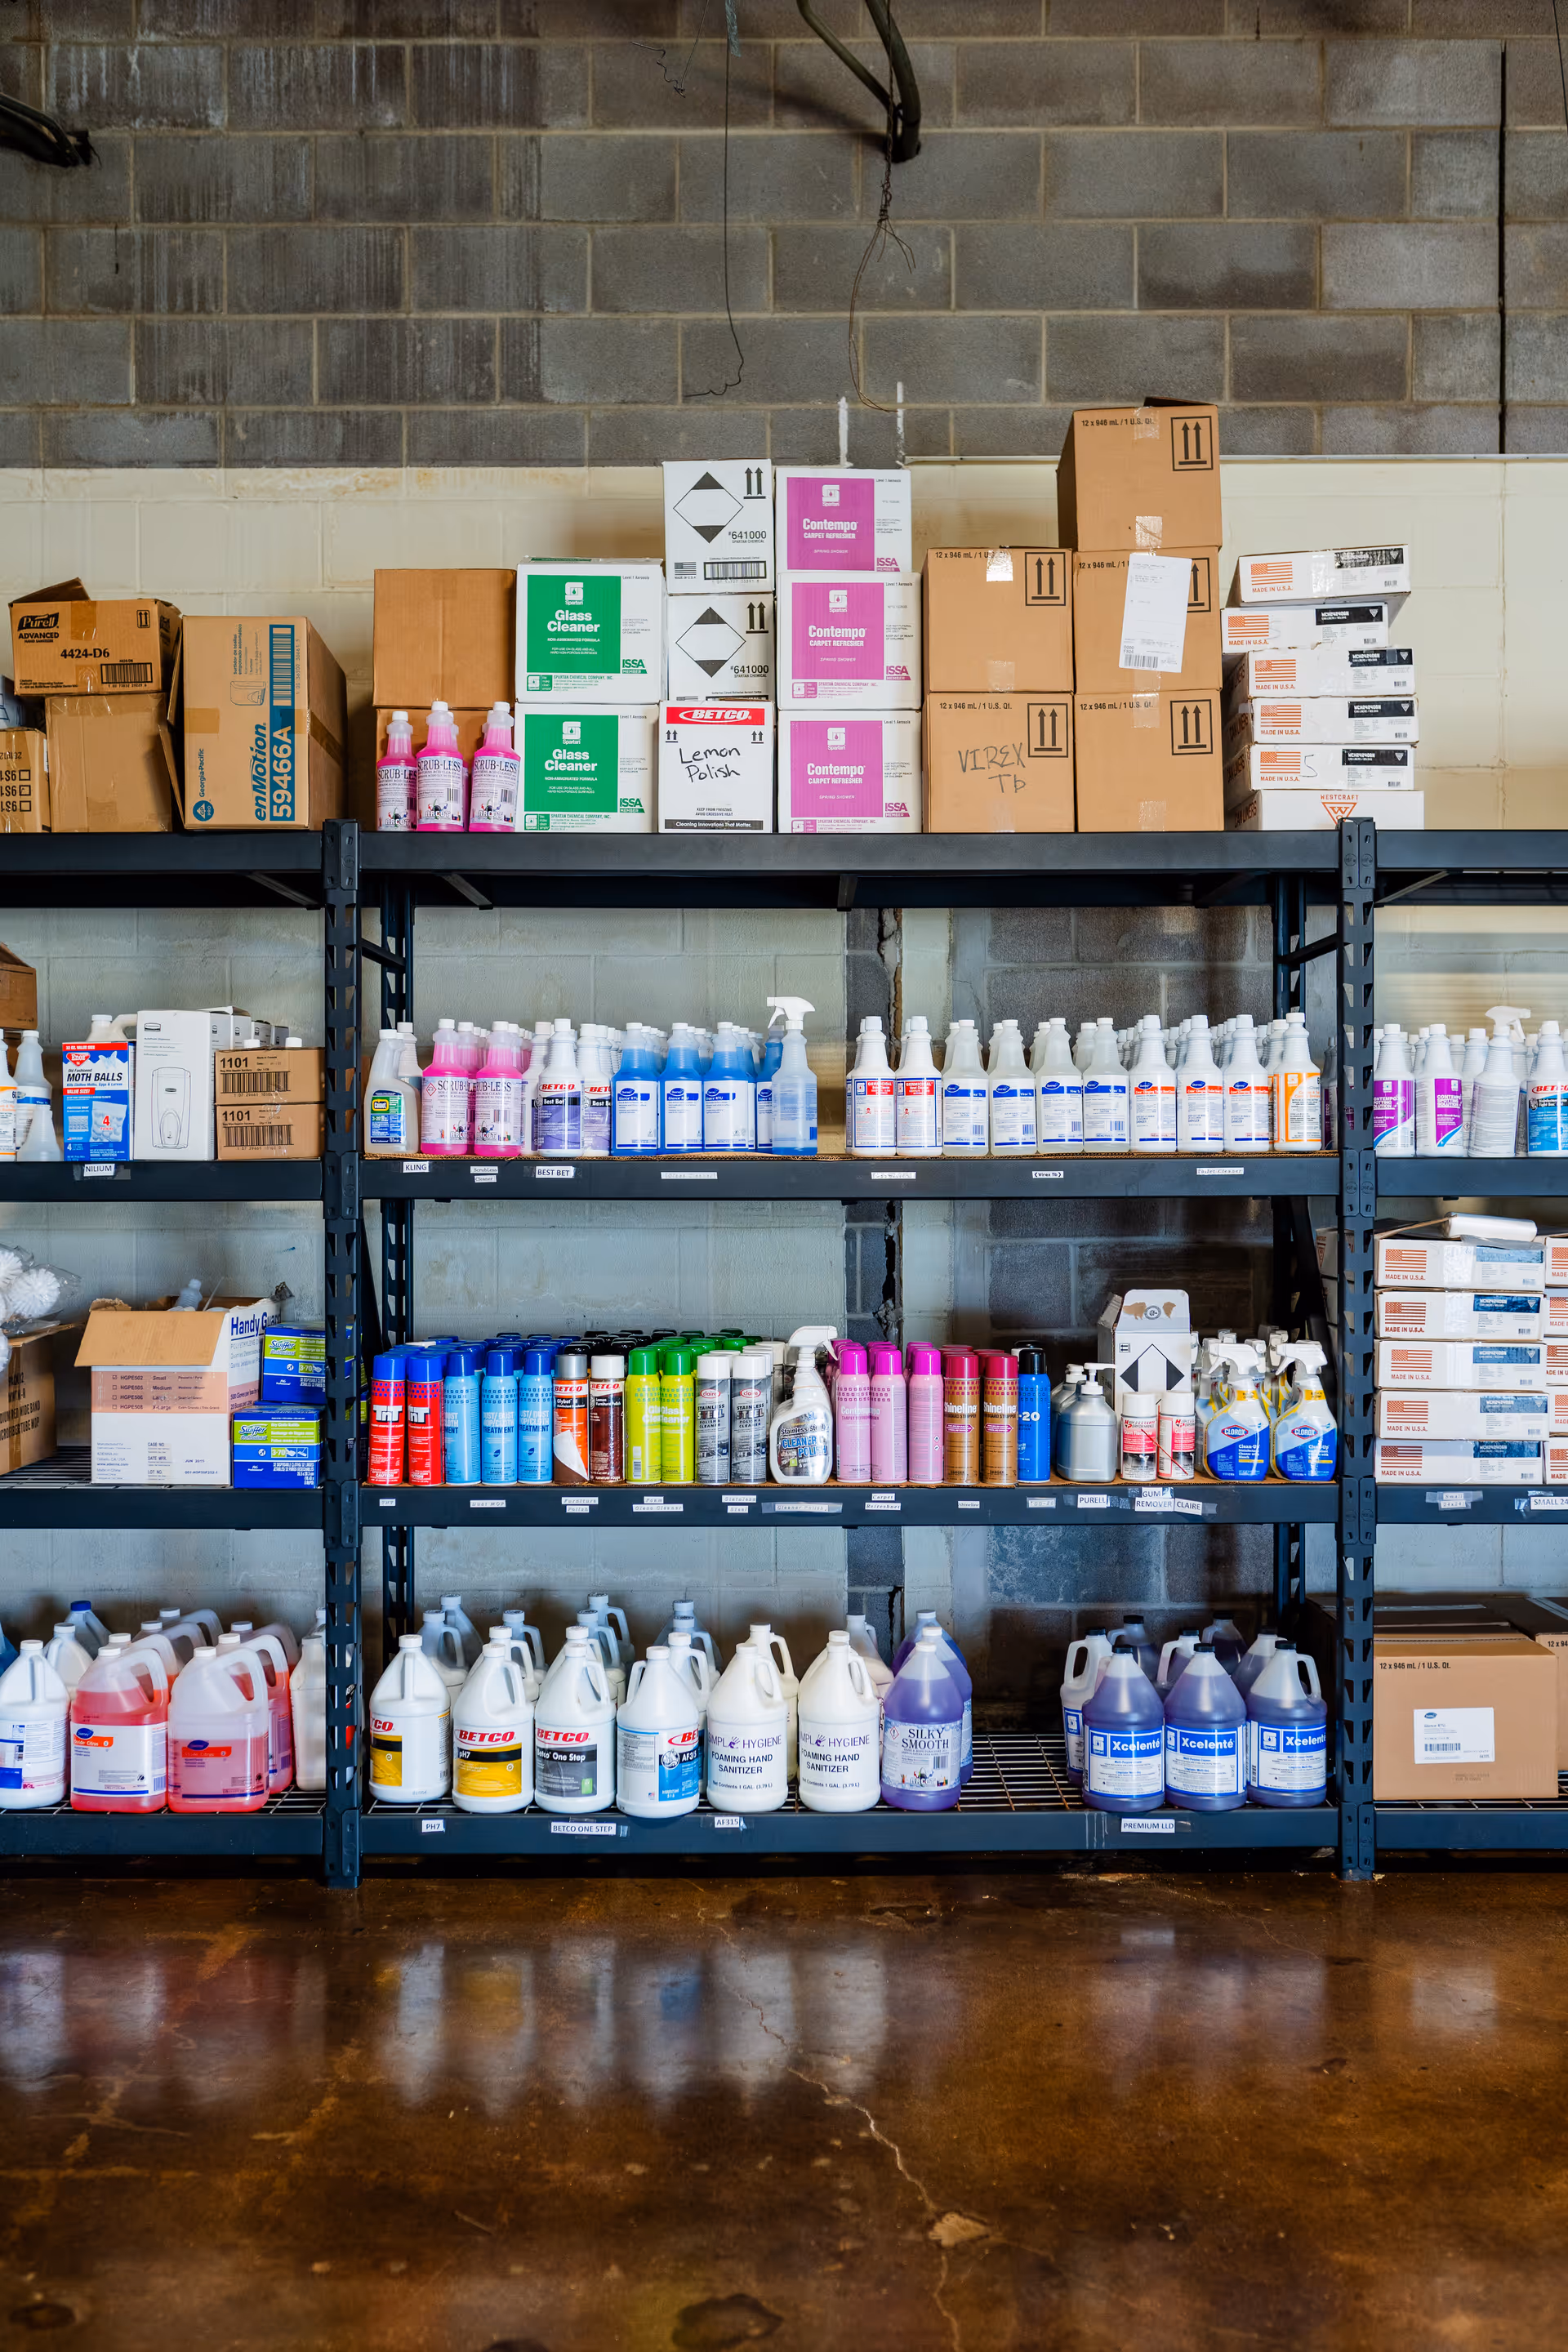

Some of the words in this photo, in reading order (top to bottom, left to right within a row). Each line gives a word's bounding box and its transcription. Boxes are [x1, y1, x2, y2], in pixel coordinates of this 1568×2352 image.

[803, 519, 857, 532] Contempo
[877, 558, 898, 567] ISSA
[22, 615, 56, 628] Purell
[555, 610, 591, 621] Glass
[547, 621, 600, 632] Cleaner
[808, 626, 866, 639] Contempo
[61, 648, 109, 658] 4424-D6
[622, 659, 644, 668] ISSA
[886, 666, 908, 675] ISSA
[693, 710, 750, 720] BETCO
[553, 749, 589, 761] Glass
[679, 747, 740, 764] Lemon
[958, 743, 1026, 773] VIREX
[274, 726, 292, 817] 59466A
[417, 760, 461, 772] SCRUB-LESS
[474, 760, 517, 772] SCRUB-LESS
[545, 760, 597, 772] Cleaner
[808, 764, 864, 777] Contempo
[249, 724, 266, 821] enMotion
[686, 764, 740, 782] Polish
[620, 799, 642, 807] ISSA
[885, 803, 906, 812] ISSA
[220, 1058, 248, 1068] 1101
[94, 1073, 122, 1081] BALLS
[103, 1116, 109, 1125] 4
[222, 1111, 250, 1121] 1101
[231, 1314, 260, 1336] Handy
[269, 1339, 295, 1351] Swiffer
[737, 1409, 764, 1419] STEEL
[238, 1425, 266, 1435] Swiffer
[782, 1436, 817, 1449] CLEANER
[1177, 1502, 1200, 1510] CLAIRE
[458, 1730, 514, 1742] BETCO
[537, 1729, 589, 1742] BETCO
[908, 1727, 943, 1739] SILKY
[743, 1735, 782, 1748] HYGIENE
[829, 1735, 870, 1747] HYGIENE
[902, 1739, 949, 1748] SMOOTH
[1113, 1739, 1160, 1751] Xcelenté
[1182, 1737, 1233, 1749] Xcelenté
[1286, 1735, 1326, 1747] Xcelenté
[553, 1752, 566, 1760] One
[569, 1753, 586, 1762] Step
[712, 1752, 746, 1762] FOAMING
[801, 1748, 831, 1762] FOAMING
[719, 1765, 762, 1774] SANITIZER
[807, 1762, 849, 1772] SANITIZER
